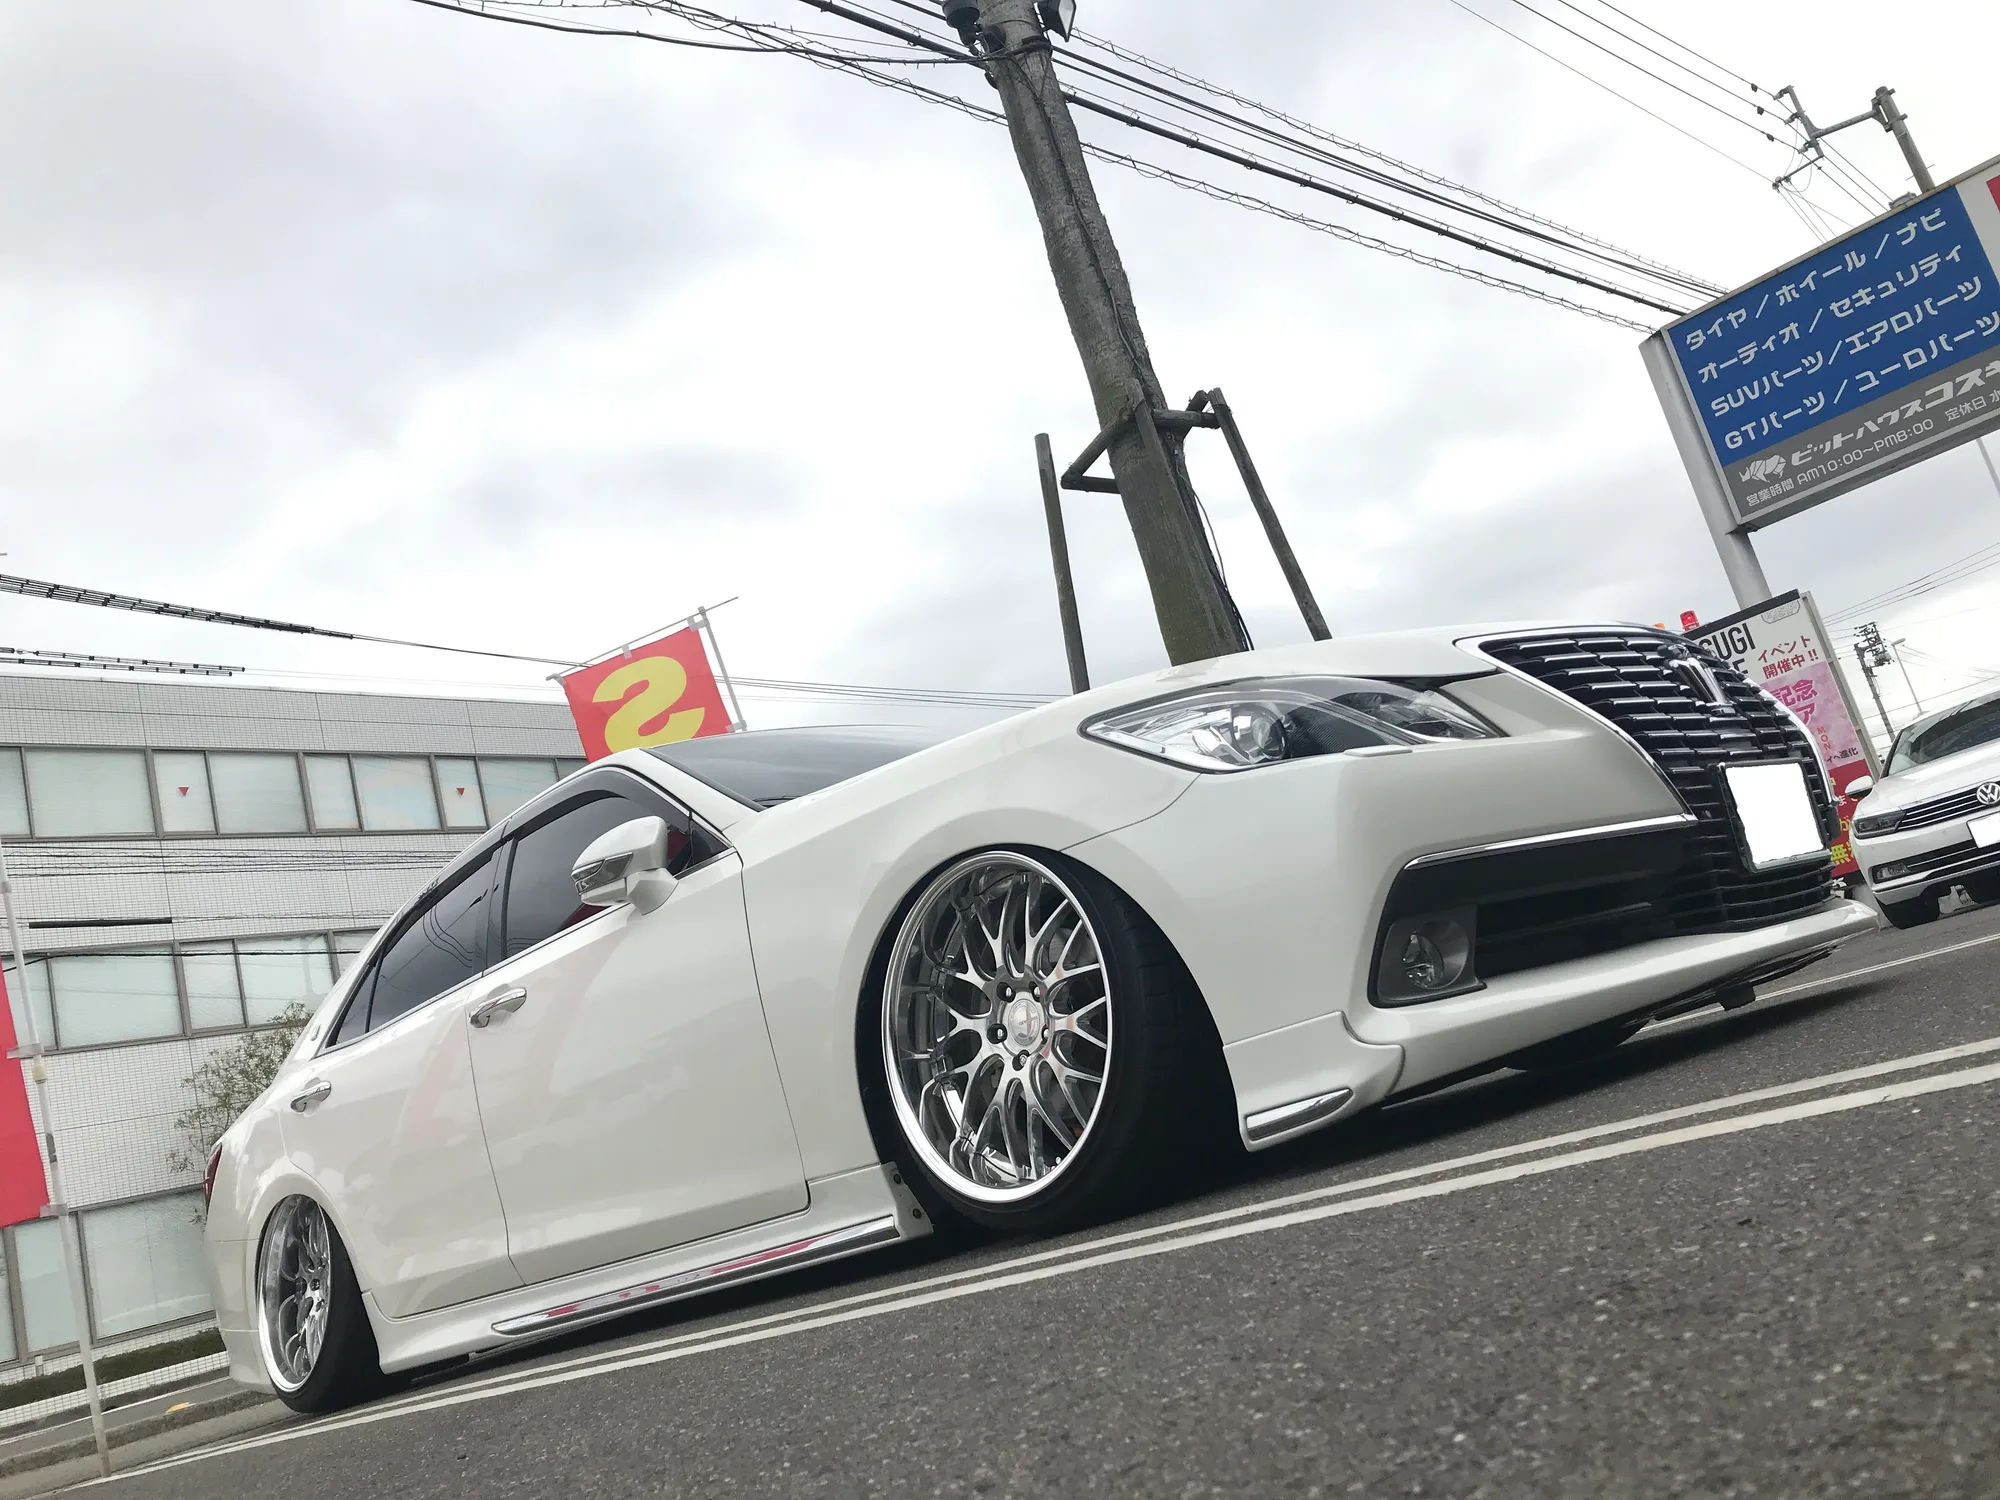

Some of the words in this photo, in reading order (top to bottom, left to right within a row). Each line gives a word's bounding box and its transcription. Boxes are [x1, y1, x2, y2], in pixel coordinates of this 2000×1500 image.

[1746, 477, 1795, 507] 営業時間
[1944, 395, 1988, 422] 定休日
[1758, 634, 1811, 663] イベント
